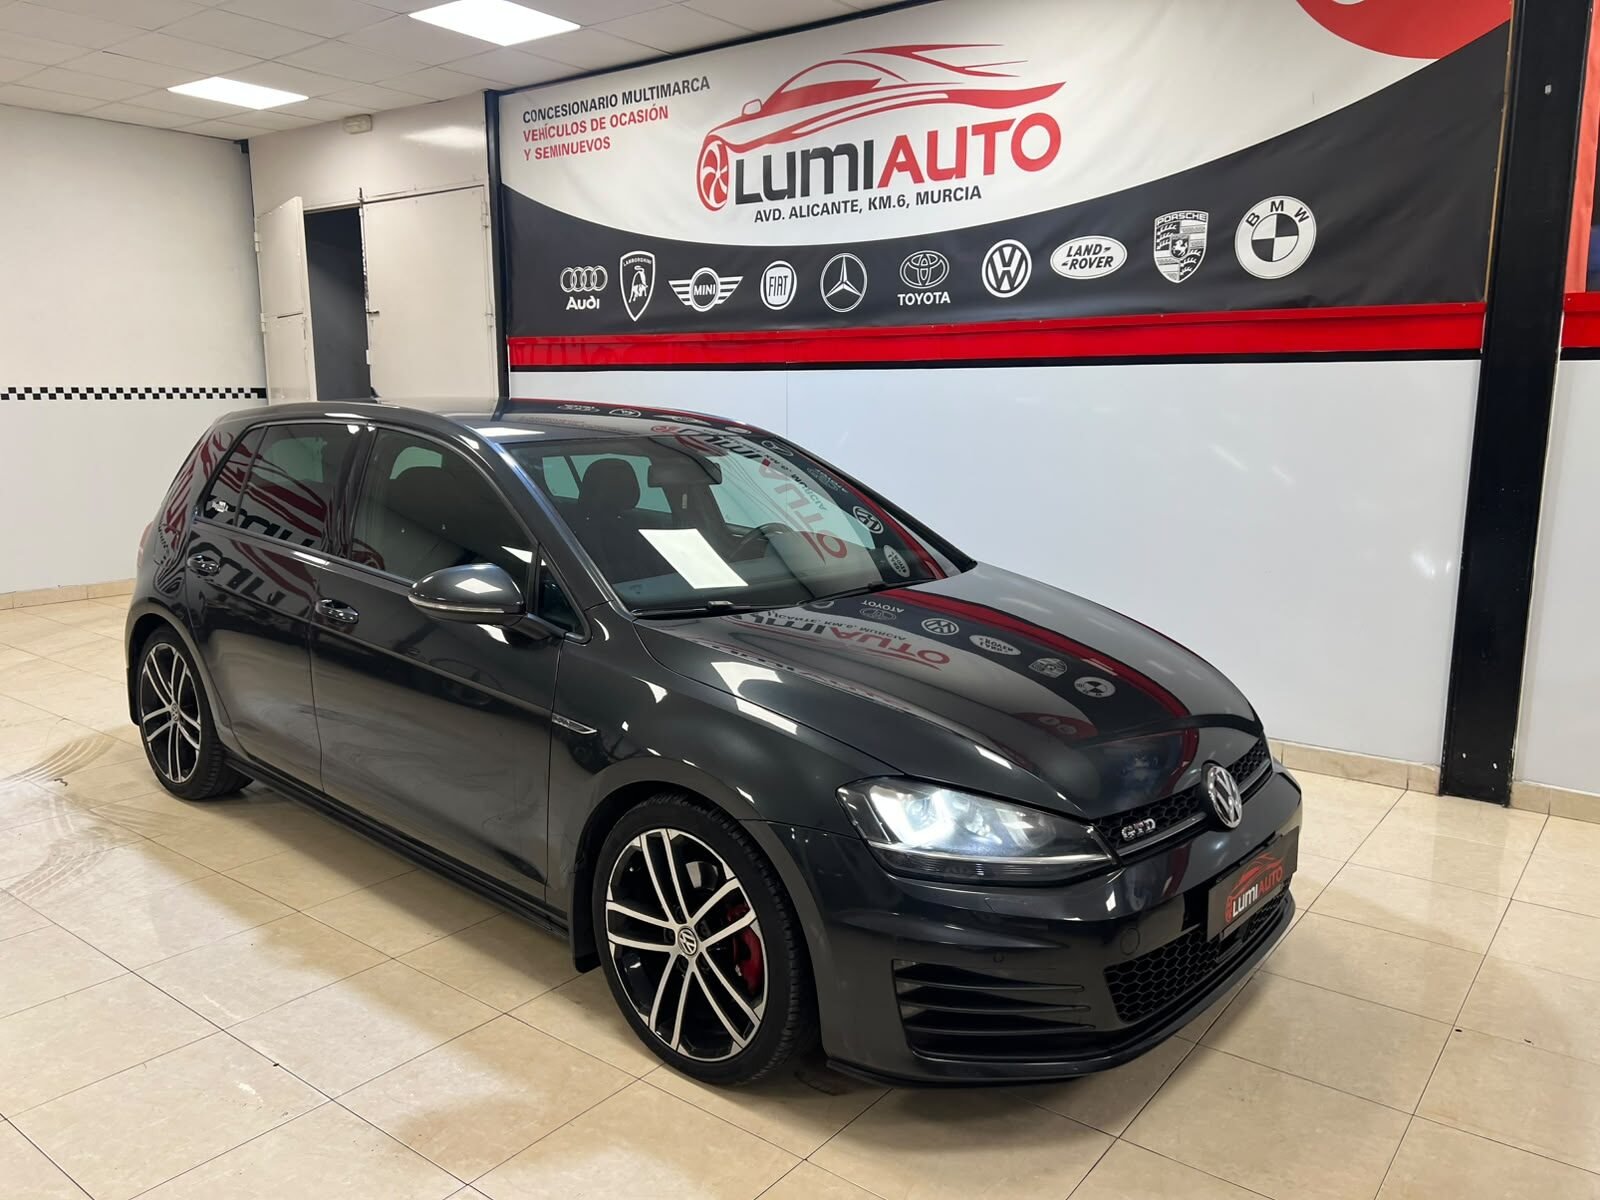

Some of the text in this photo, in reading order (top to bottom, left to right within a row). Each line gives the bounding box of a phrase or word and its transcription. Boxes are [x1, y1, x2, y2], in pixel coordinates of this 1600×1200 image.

[523, 75, 710, 124] CONCESIONARIO MULTIMARCA
[523, 103, 669, 143] VEHÍCULOS DE OCASIÓN
[524, 136, 611, 161] Y SEMINUEVOS
[754, 185, 982, 223] AVD. ALICANTE, KM.6, MURCIA
[1245, 199, 1310, 228] BMW
[1156, 212, 1207, 225] PORSCHE
[693, 283, 717, 297] MINI
[767, 274, 789, 297] FIAT
[565, 295, 600, 311] Audi
[897, 291, 951, 306] TOYOTA
